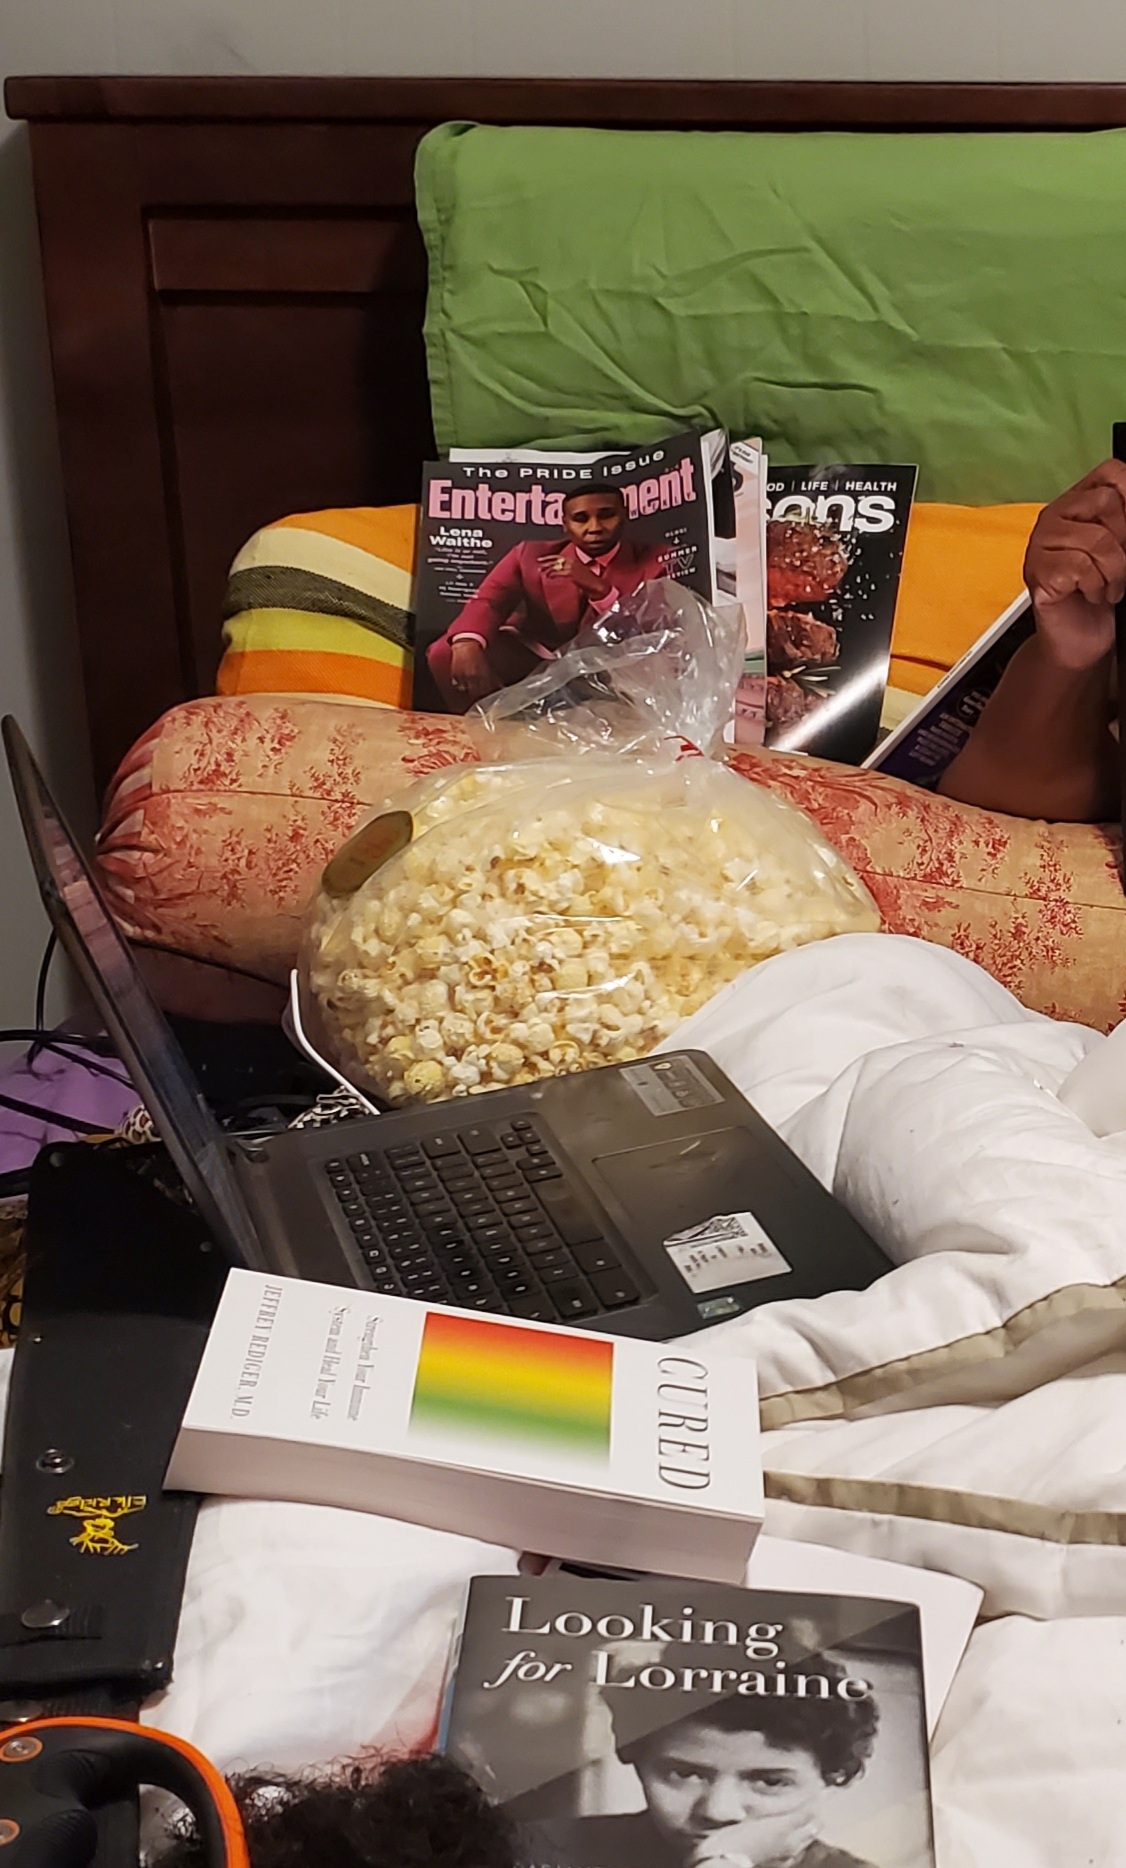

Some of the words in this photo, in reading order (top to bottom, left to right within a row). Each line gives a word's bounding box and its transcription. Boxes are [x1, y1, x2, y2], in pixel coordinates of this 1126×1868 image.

[462, 466, 508, 479] The
[519, 468, 593, 479] PRIDE
[428, 456, 697, 526] Entertament
[766, 482, 785, 492] OD
[801, 481, 829, 491] LIFE
[845, 481, 897, 492] HEALTH
[429, 535, 493, 548] Waithe
[439, 526, 484, 539] Lena
[657, 546, 698, 563] SUMMER
[254, 1284, 283, 1332] JEFFREY
[328, 1306, 351, 1336] System
[325, 1338, 342, 1354] and
[320, 1356, 341, 1376] Heal
[354, 1363, 375, 1383] Your
[315, 1378, 336, 1399] Your
[229, 1396, 254, 1419] M.D.
[310, 1399, 331, 1420] Life
[656, 1355, 711, 1491] CURED
[502, 1596, 784, 1660] Looking
[483, 1651, 573, 1689] for
[594, 1651, 874, 1700] Lorraine
